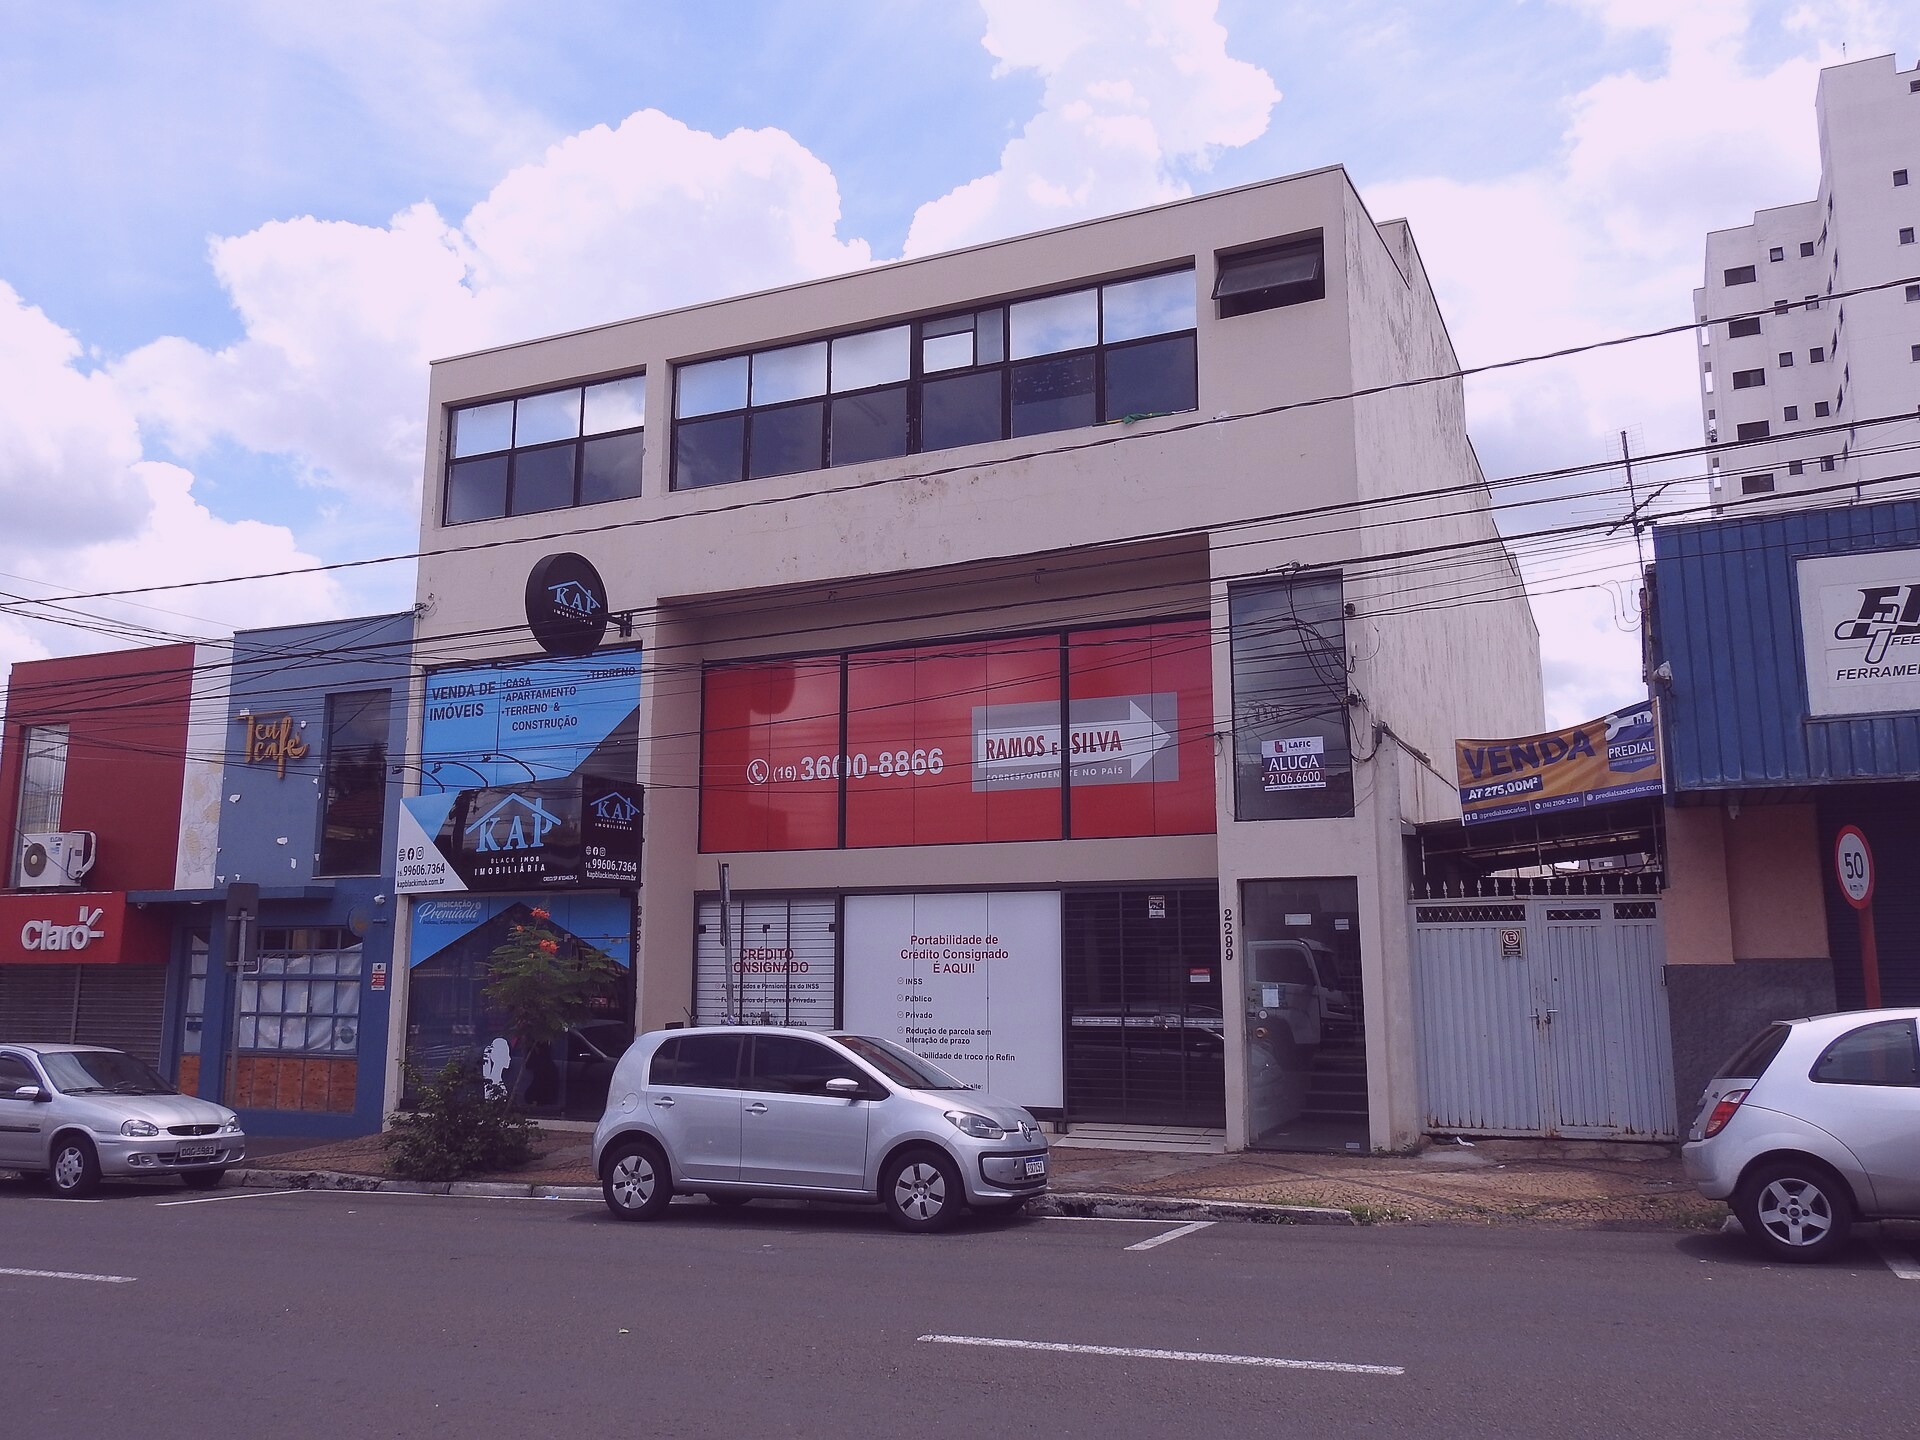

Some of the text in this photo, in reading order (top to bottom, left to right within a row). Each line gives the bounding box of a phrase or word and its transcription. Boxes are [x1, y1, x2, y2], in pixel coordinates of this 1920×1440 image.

[554, 587, 597, 615] KAP
[590, 666, 636, 680] TERRENO
[1836, 663, 1920, 681] FERRAME
[506, 677, 531, 689] CASA
[431, 681, 496, 701] VENDA DE
[506, 685, 577, 702] APARTAMENTO
[429, 700, 485, 722] IMÓVEIS
[504, 702, 561, 717] TERRENO &
[511, 714, 578, 731] CONSTRUÇÃO
[986, 735, 1046, 760] RAMOS
[1071, 730, 1122, 755] SILVA
[1288, 740, 1311, 749] LAFIC
[1608, 741, 1655, 759] PREDIAL
[1462, 728, 1597, 779] VENDA
[773, 747, 944, 782] (16) 3600-8866
[1083, 768, 1097, 776] NO
[1101, 765, 1123, 775] PAÍS
[1268, 754, 1320, 772] ALUGA
[1268, 771, 1321, 785] 2106.6600
[1469, 788, 1484, 801] AT
[596, 801, 637, 821] KAP
[475, 812, 553, 853] KAP
[474, 863, 546, 876] IMOBILIÁRIA
[1844, 851, 1864, 880] 50
[436, 900, 472, 910] INDICAÇÃO
[417, 902, 478, 924] Premiada
[21, 919, 92, 951] Claro
[910, 934, 999, 945] Portabilidade de
[1223, 908, 1234, 961] 2299
[740, 946, 794, 961] CRÉDITO
[900, 948, 1009, 961] Crédito Consignado
[733, 961, 809, 974] ONSIGNADO
[933, 960, 975, 974] É AQUI!
[904, 994, 933, 1002] Público
[905, 1011, 933, 1019] Privado
[905, 1026, 937, 1036] Redução
[938, 1027, 947, 1035] de
[948, 1028, 975, 1036] parcela
[905, 1036, 938, 1045] alteração
[949, 1038, 971, 1046] prazo
[953, 1052, 963, 1060] de
[964, 1053, 984, 1061] troco
[995, 1053, 1016, 1062] Refin
